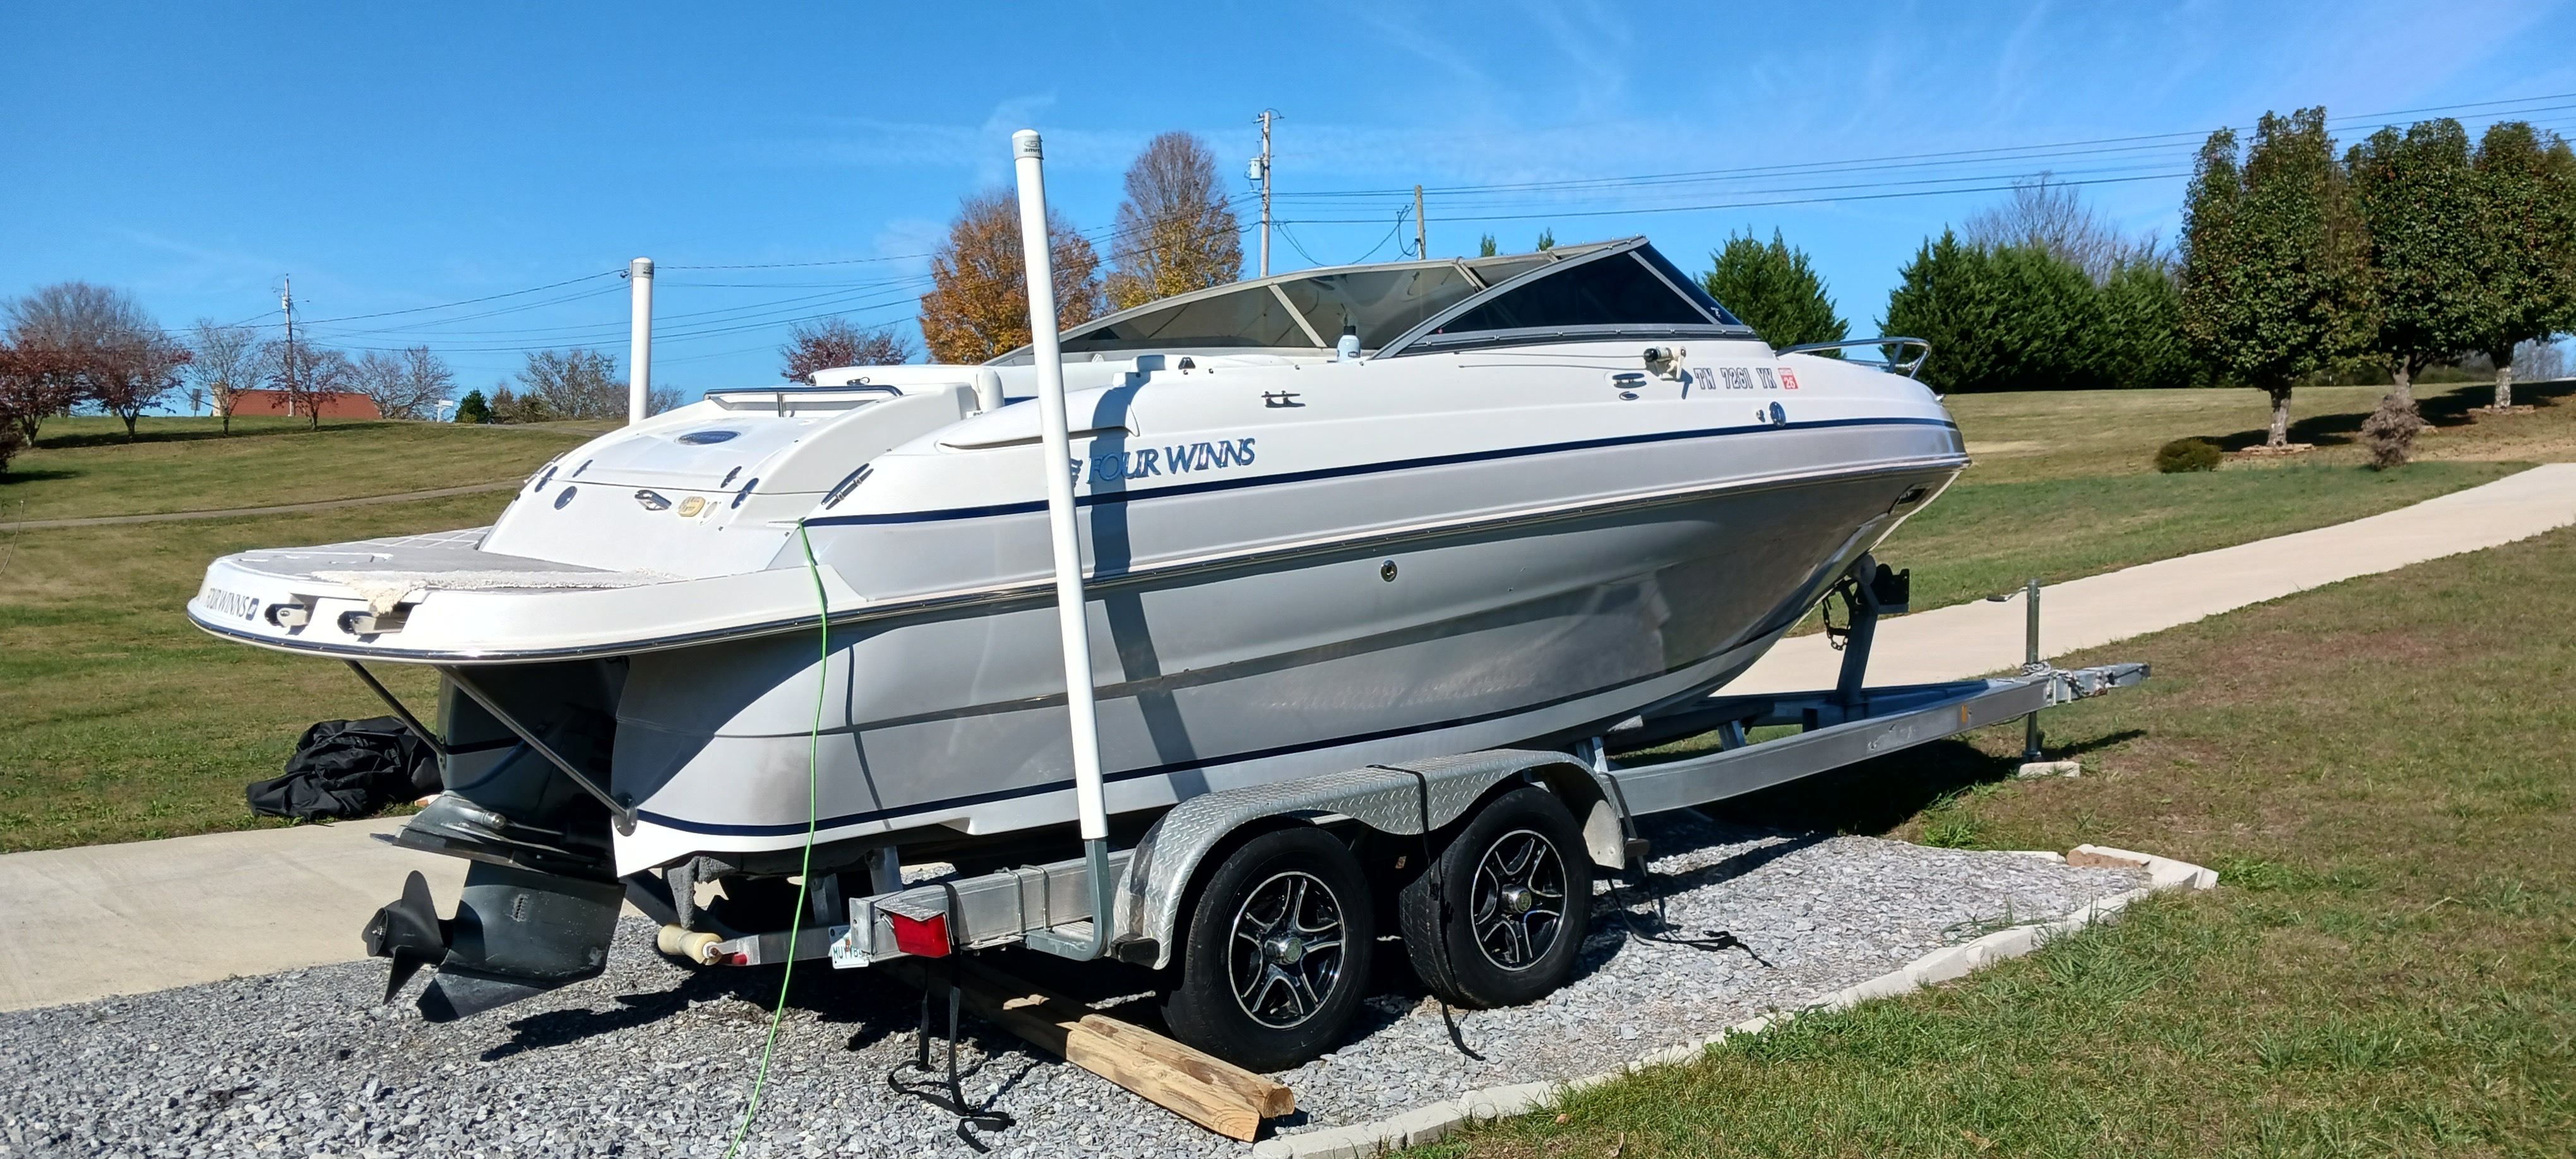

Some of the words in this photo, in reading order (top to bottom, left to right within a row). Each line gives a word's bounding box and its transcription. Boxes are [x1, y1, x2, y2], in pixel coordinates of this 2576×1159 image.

[1693, 368, 1716, 389] TN
[1719, 367, 1753, 389] 7261
[1086, 448, 1161, 484] FOUR
[1163, 438, 1255, 475] WINNS
[217, 591, 249, 617] WINNS
